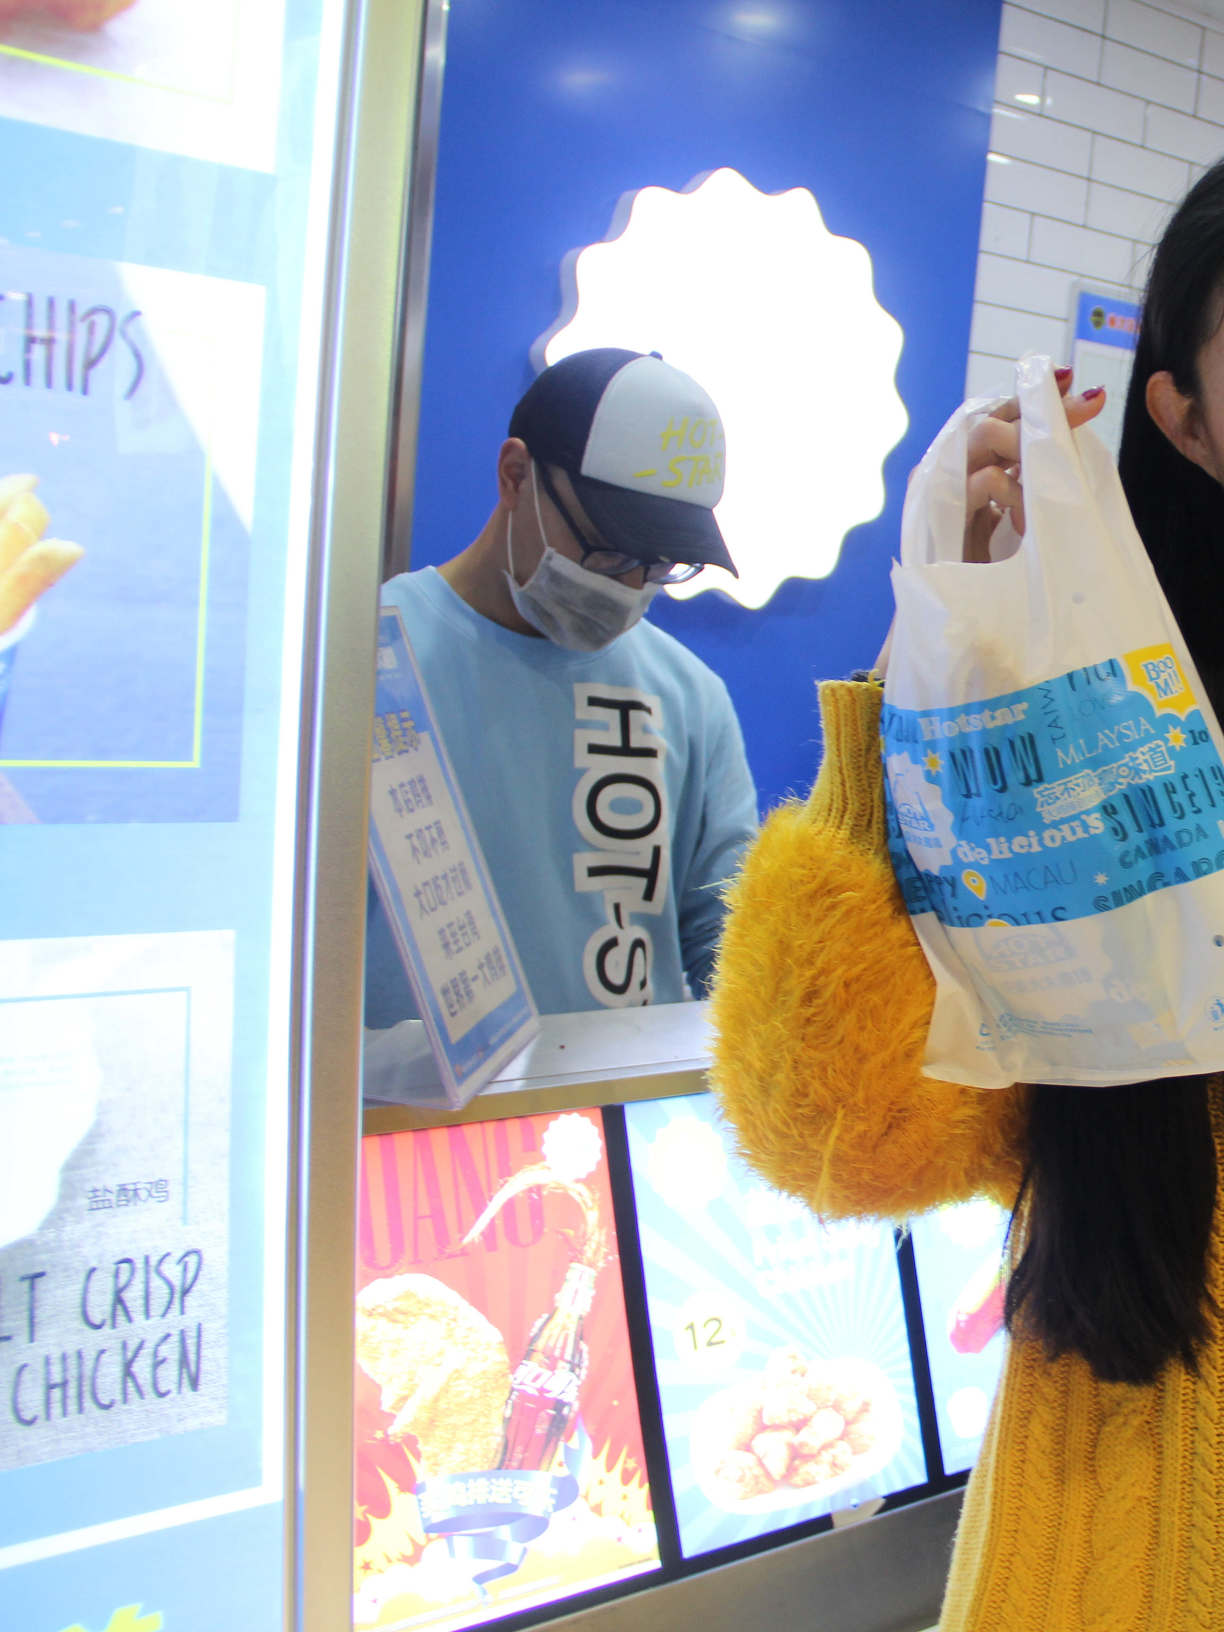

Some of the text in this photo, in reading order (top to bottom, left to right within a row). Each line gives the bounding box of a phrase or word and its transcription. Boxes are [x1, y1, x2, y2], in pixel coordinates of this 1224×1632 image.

[1055, 715, 1156, 769] MLAYSIA
[0, 1248, 204, 1343] T CRISP
[684, 1316, 727, 1351] 12
[12, 1322, 204, 1427] CHICKEN
